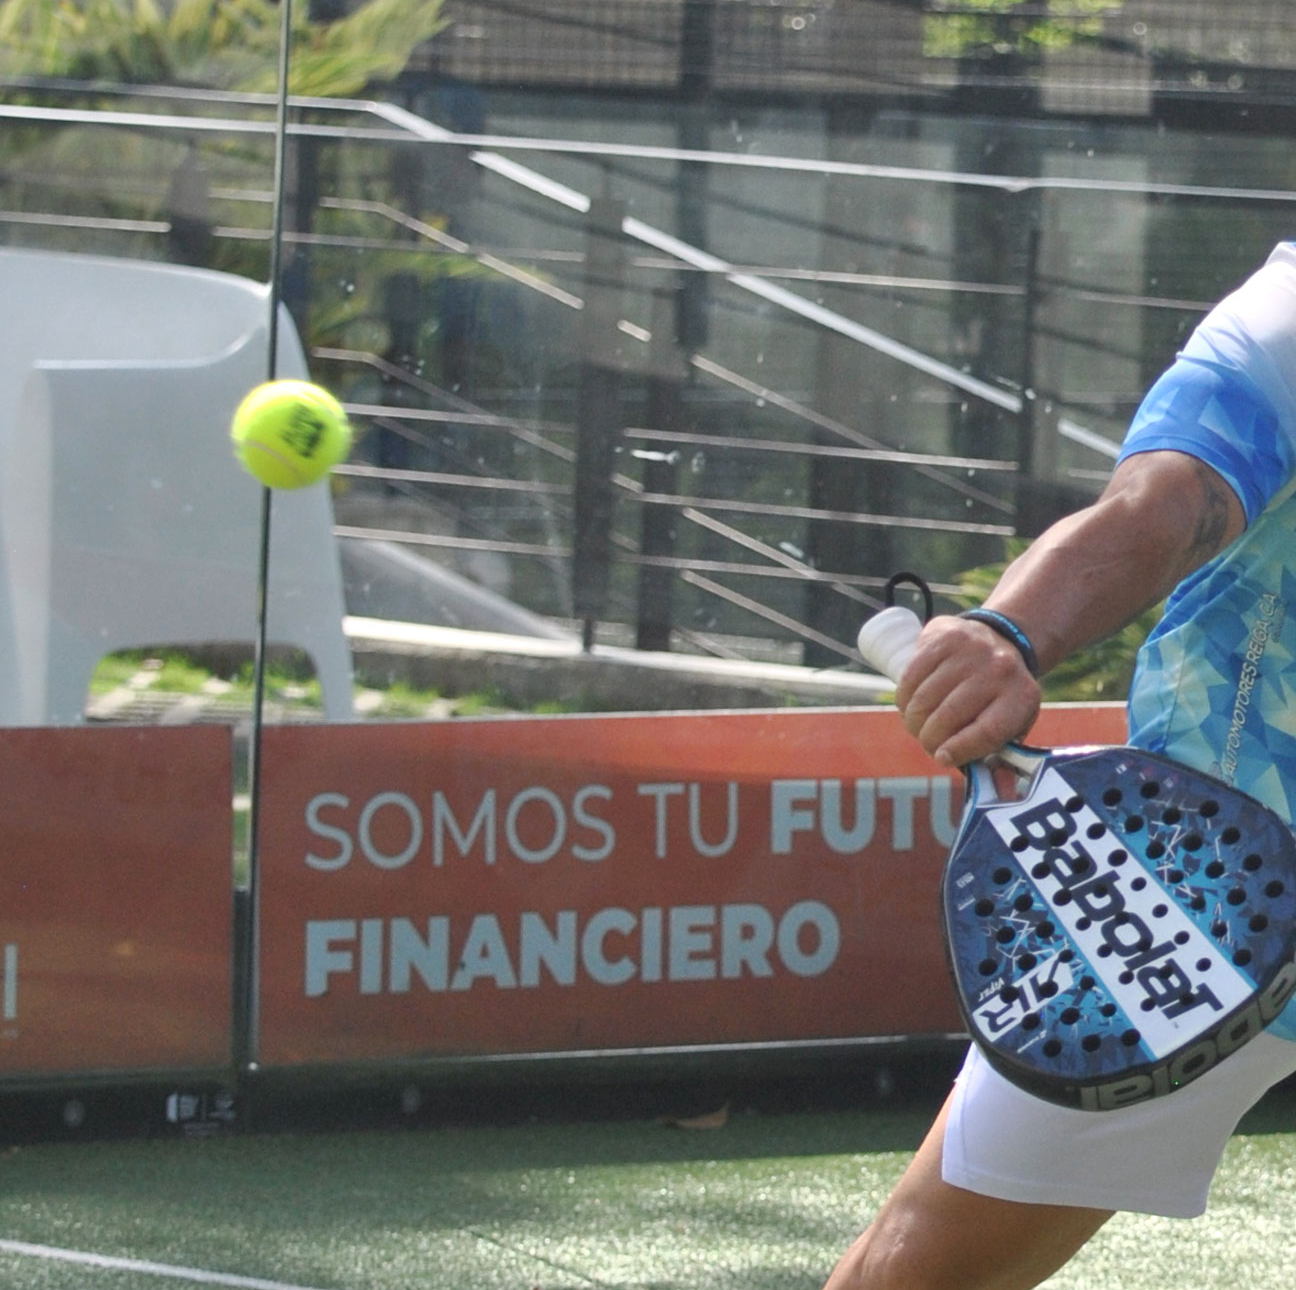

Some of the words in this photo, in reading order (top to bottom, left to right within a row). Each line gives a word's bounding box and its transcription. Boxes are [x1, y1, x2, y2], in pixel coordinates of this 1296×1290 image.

[303, 784, 616, 873] SOMOS
[636, 780, 740, 858] TU
[771, 775, 958, 856] FUTU
[303, 901, 842, 998] FINANCIERO
